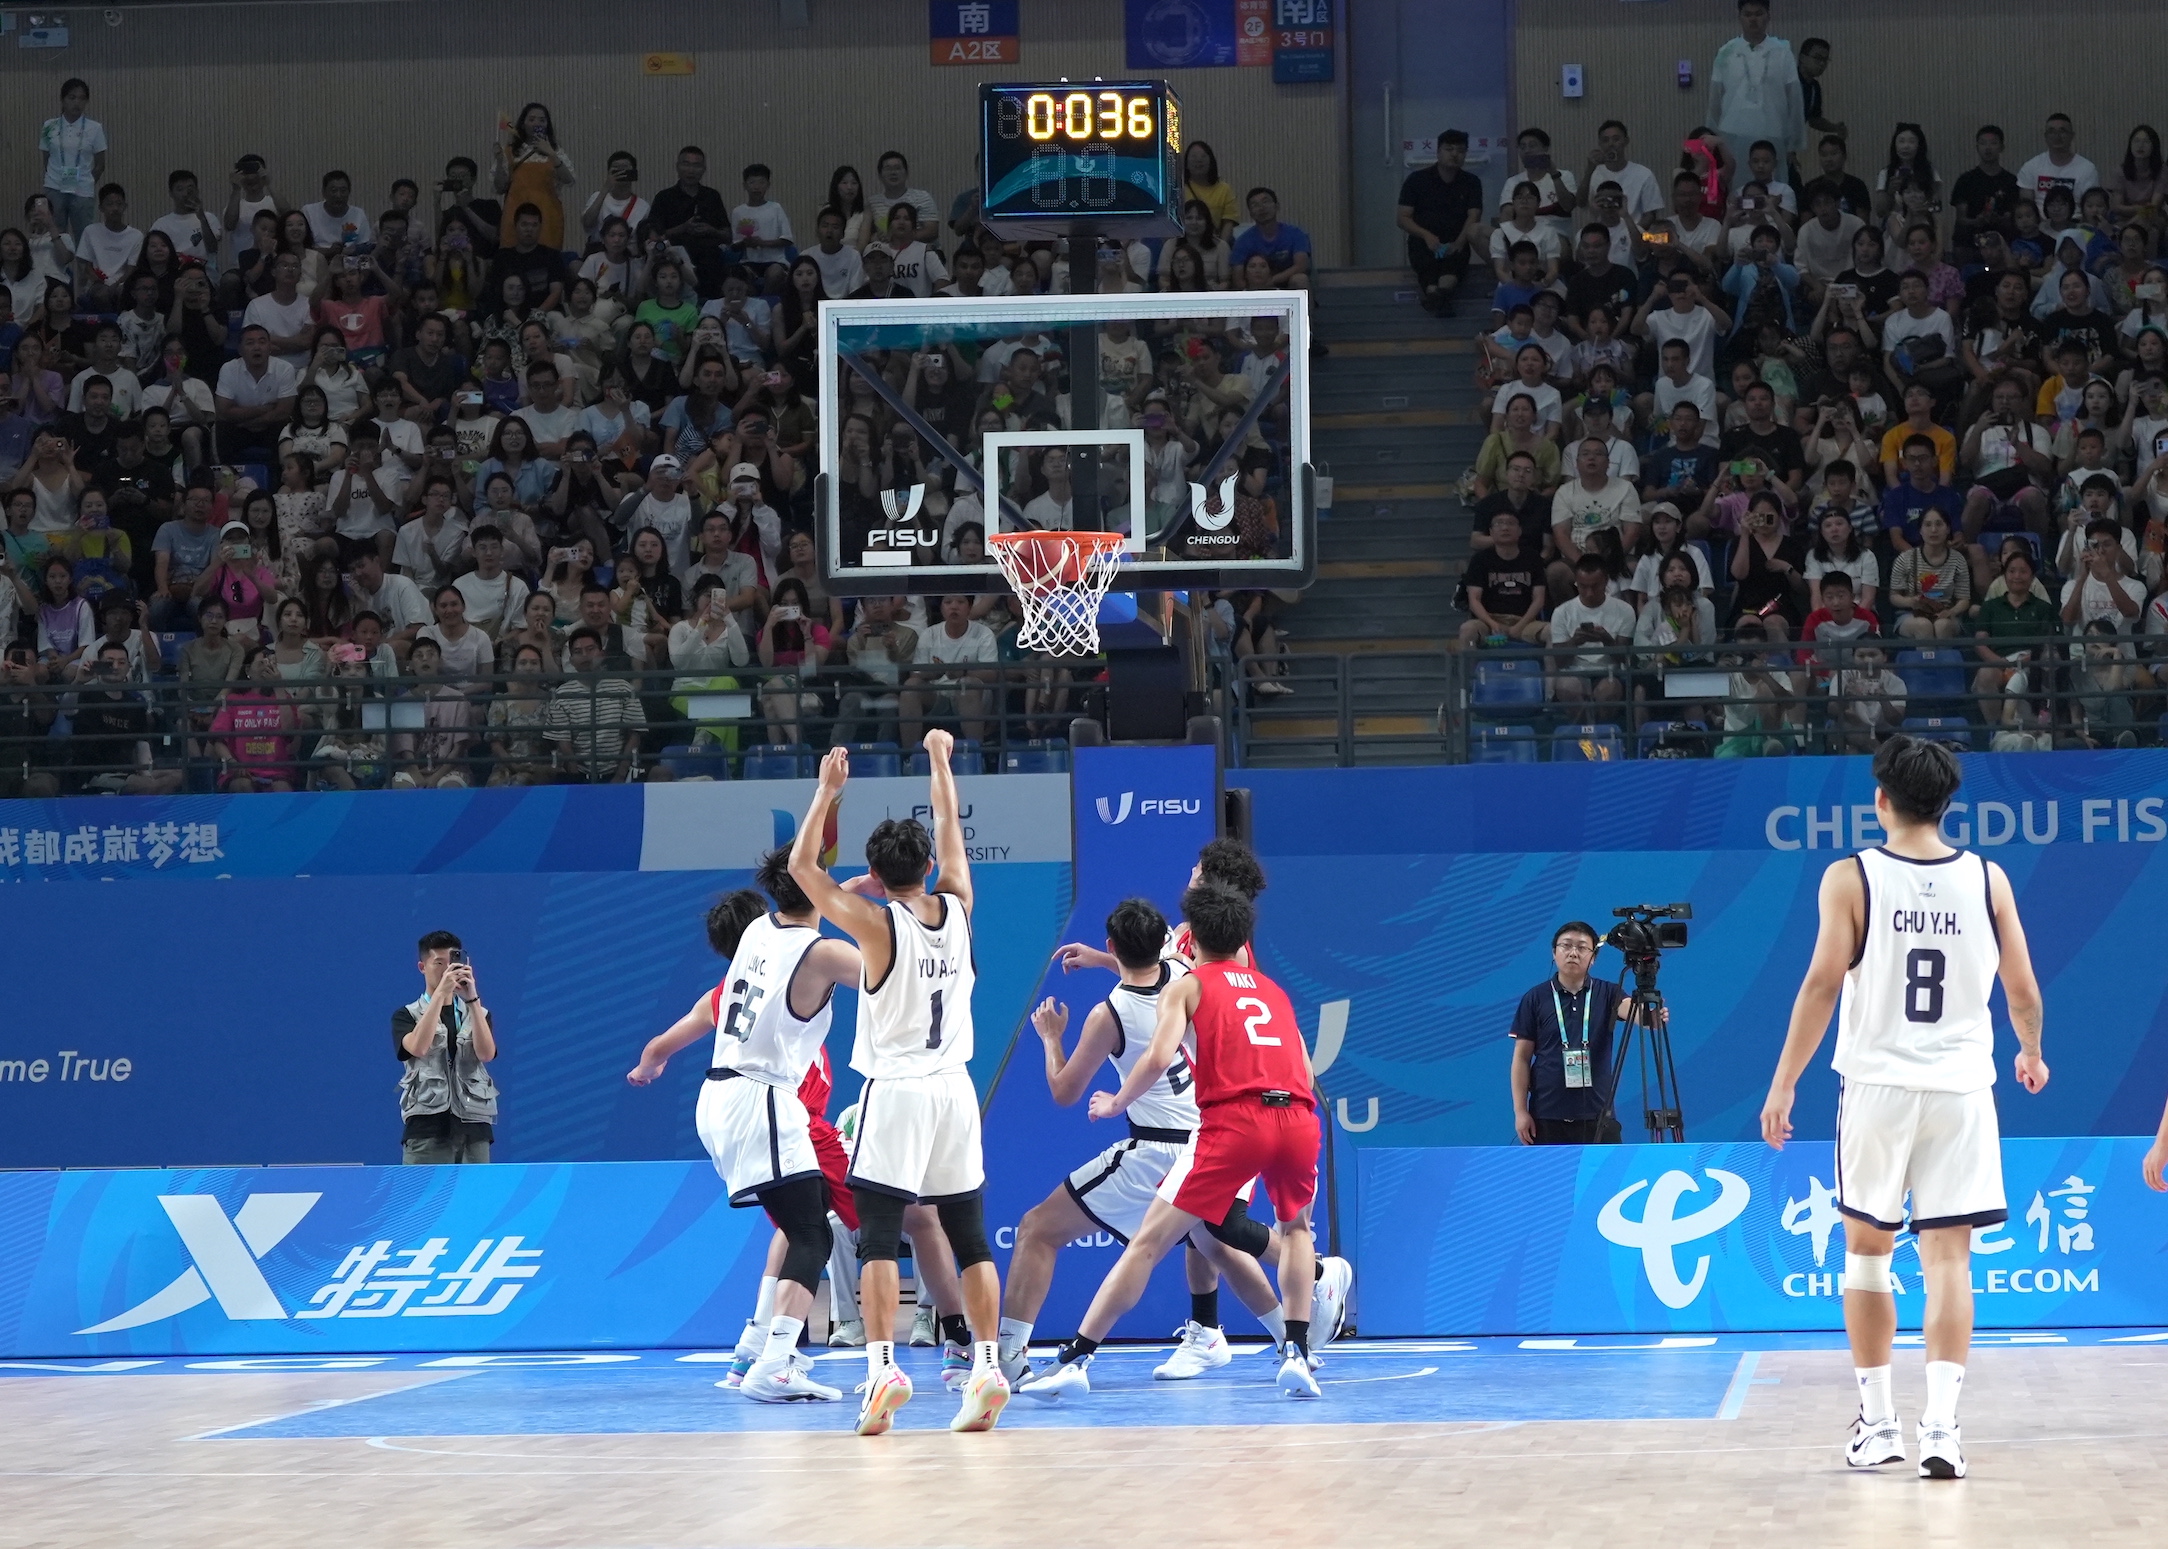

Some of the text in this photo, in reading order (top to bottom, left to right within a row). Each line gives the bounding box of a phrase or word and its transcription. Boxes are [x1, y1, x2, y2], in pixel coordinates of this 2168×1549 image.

[957, 2, 990, 34] 南
[1246, 21, 1262, 32] 2F
[948, 40, 1002, 60] A2区
[1281, 30, 1324, 47] 3号门
[867, 528, 938, 547] FISU
[1186, 535, 1241, 545] CHENGDU
[911, 804, 973, 820] FIU
[1140, 798, 1200, 816] FISU
[1765, 796, 2168, 851] CHEGDU FIS
[1893, 909, 1962, 935] CHU Y.H.
[918, 958, 935, 979] YU
[1223, 971, 1257, 990] WAKI
[1905, 948, 1946, 1024] 8
[723, 978, 765, 1044] 25
[925, 989, 943, 1050] 1
[1235, 996, 1282, 1047] 2
[58, 1050, 132, 1082] True
[292, 1235, 544, 1320] 特步
[1782, 1272, 1907, 1298] CHIA
